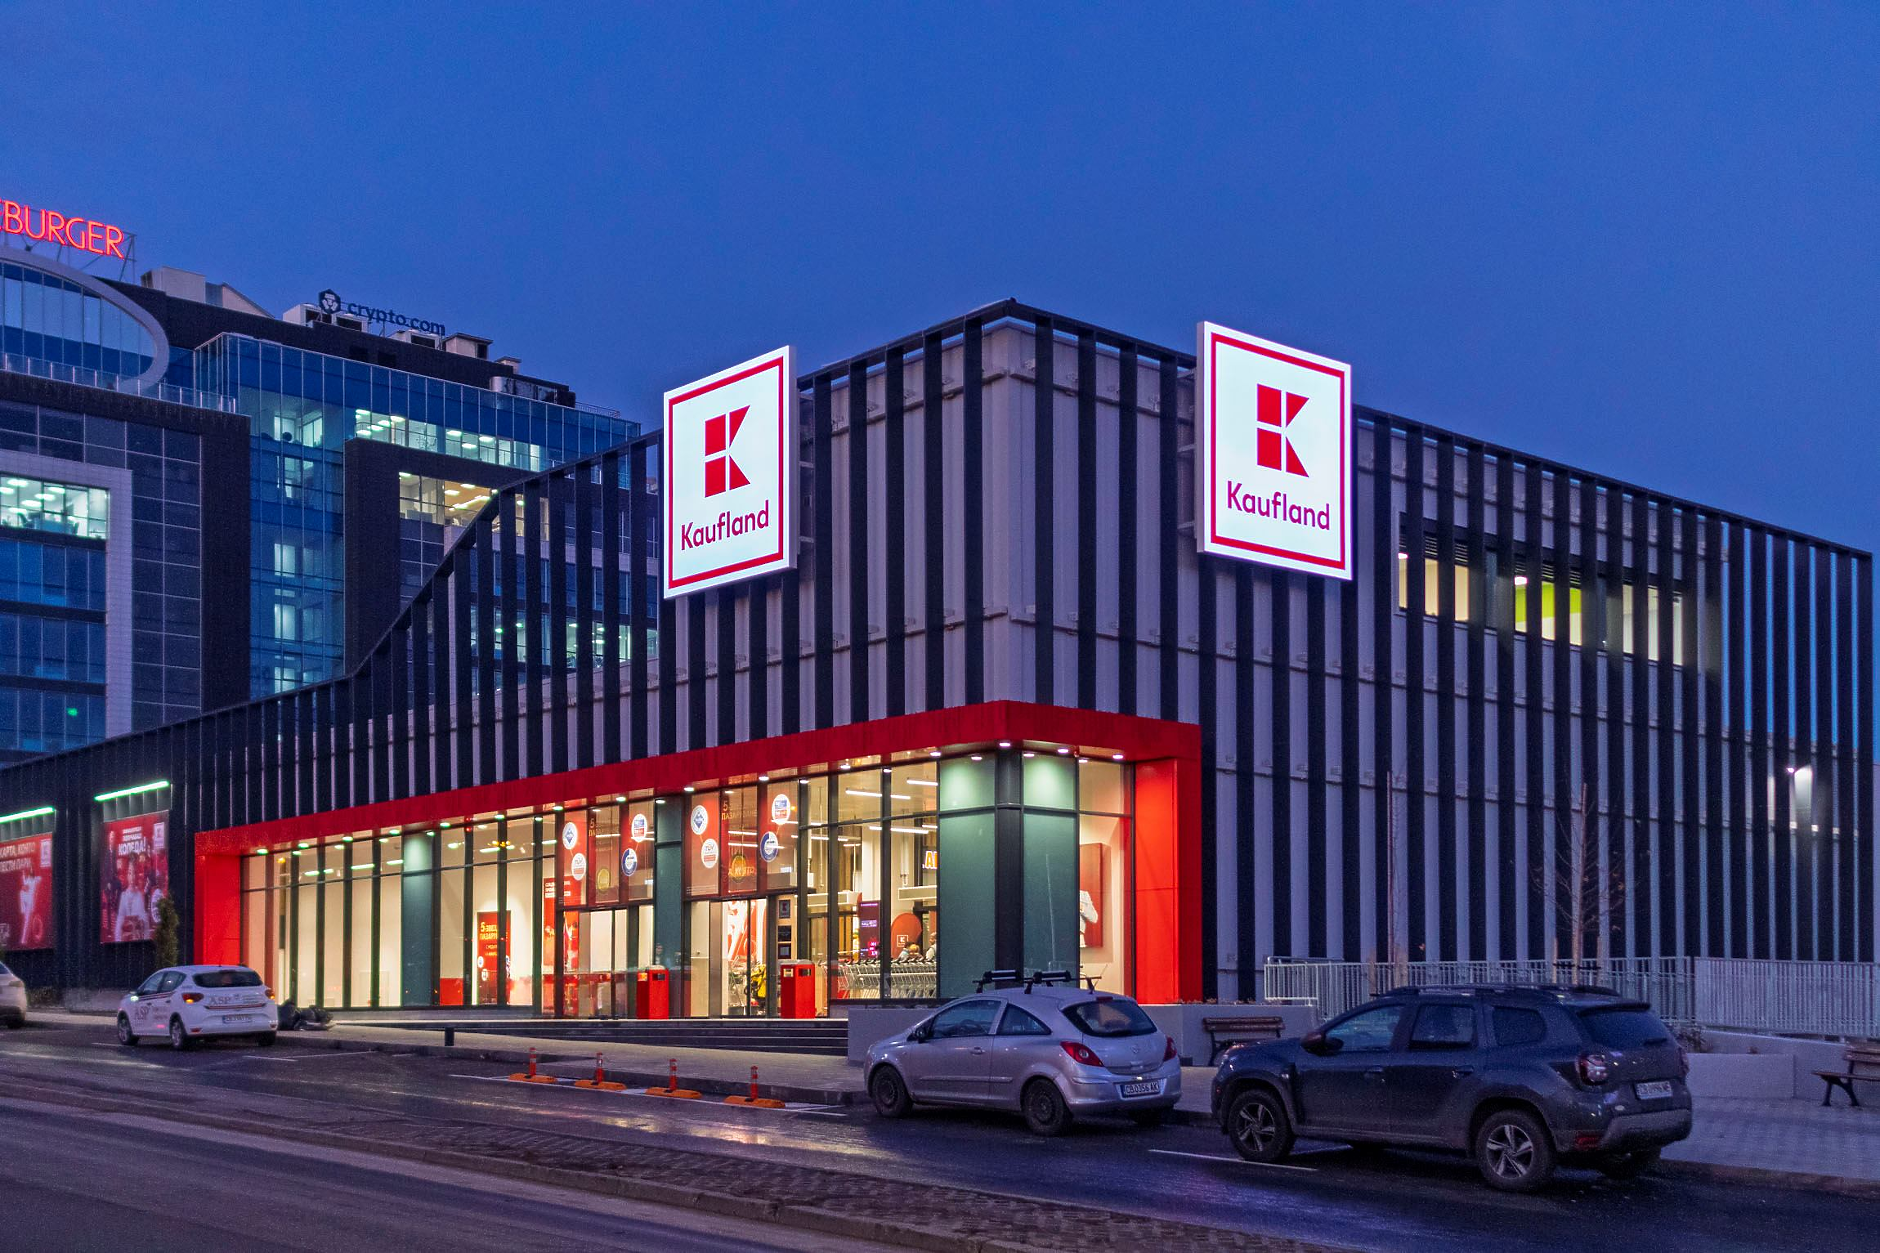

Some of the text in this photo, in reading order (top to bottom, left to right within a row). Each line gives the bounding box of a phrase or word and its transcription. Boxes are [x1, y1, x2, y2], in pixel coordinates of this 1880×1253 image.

[0, 198, 124, 259] BURGER
[347, 302, 446, 336] crypto.com
[681, 499, 769, 551] Kaufland
[1227, 480, 1330, 531] Kaufland
